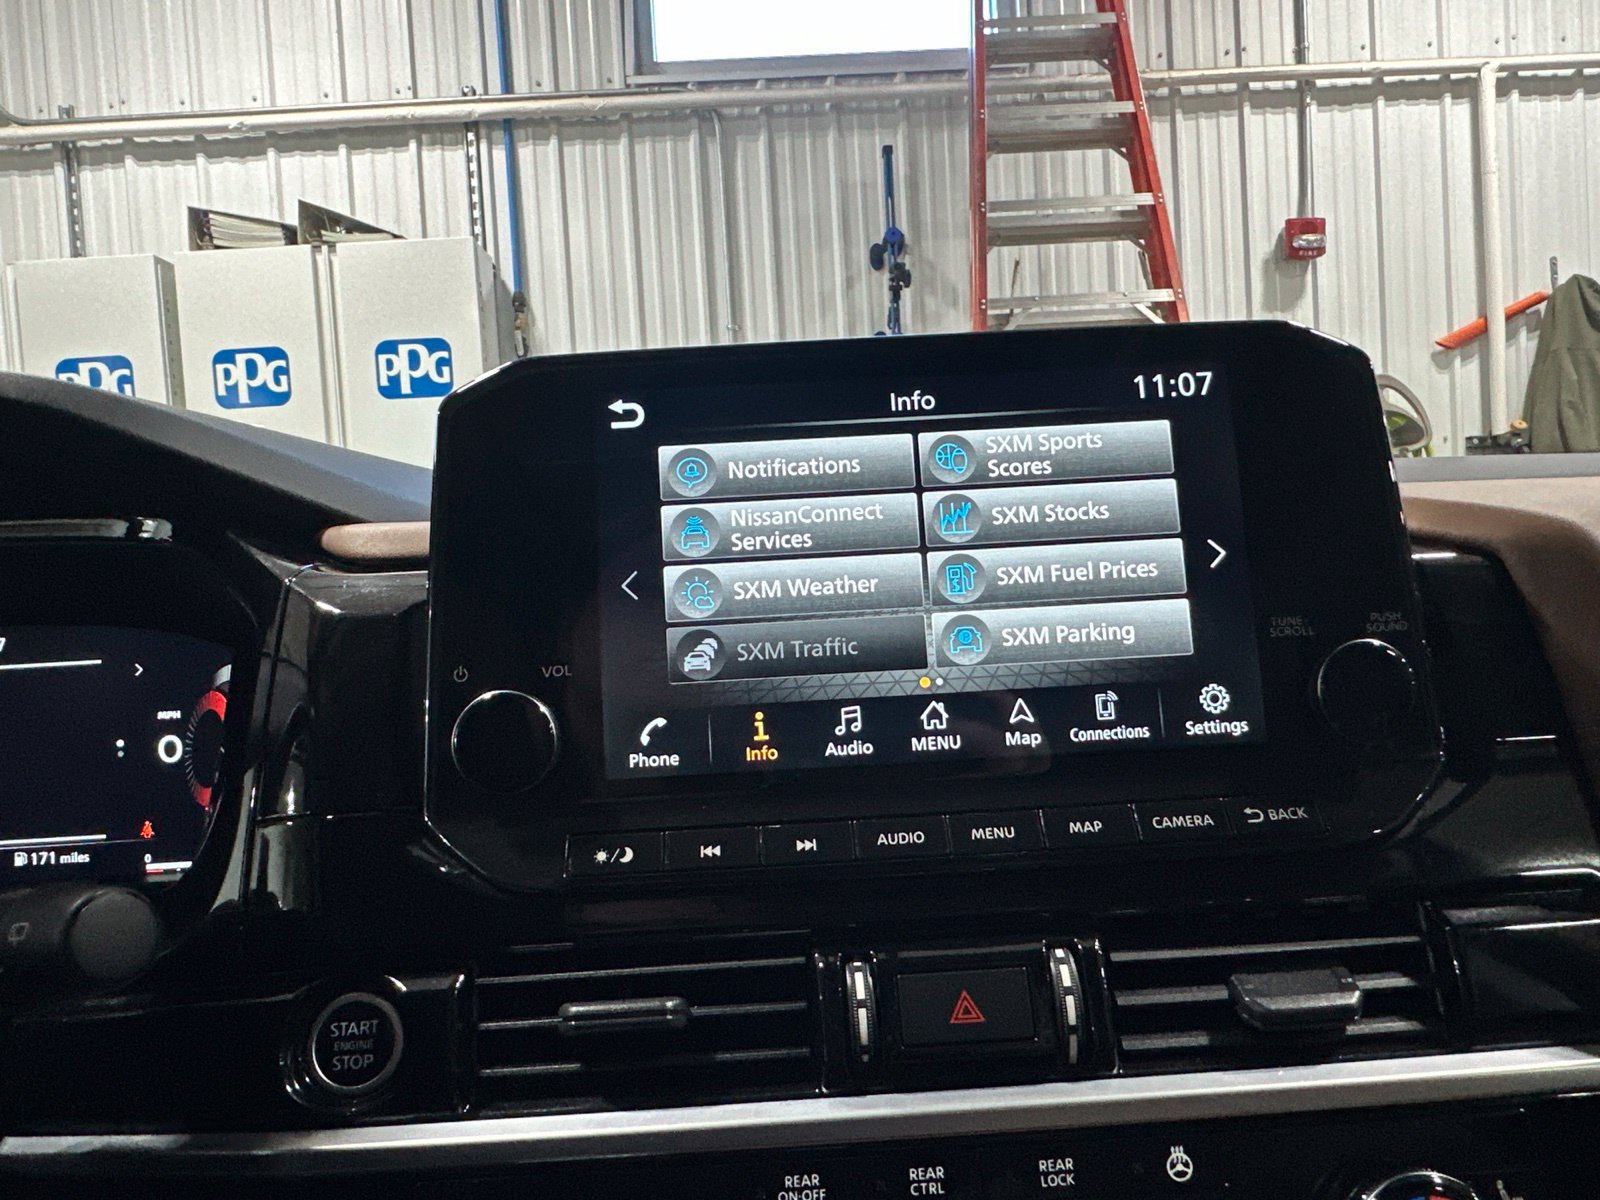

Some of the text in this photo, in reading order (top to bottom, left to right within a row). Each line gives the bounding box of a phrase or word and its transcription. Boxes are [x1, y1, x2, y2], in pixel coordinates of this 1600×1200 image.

[215, 352, 289, 403] PPG
[377, 343, 451, 395] PPG
[1133, 371, 1213, 399] 11:07
[890, 390, 935, 412] Info
[986, 431, 1103, 455] SXM Sports
[728, 457, 861, 479] Notifications
[988, 458, 1052, 478] Scores
[731, 503, 884, 527] NissanConnect
[992, 501, 1110, 525] SXM Stocks
[731, 531, 813, 551] Services
[996, 561, 1158, 585] SXM Fuel Prices
[733, 575, 879, 600] SXM Weather
[1001, 622, 1135, 647] SXM Parking
[1269, 626, 1315, 637] SCROLL
[737, 637, 859, 661] SXM Traffic
[541, 664, 572, 678] VOL
[157, 710, 181, 720] MPH
[1069, 725, 1150, 743] Connections
[1185, 719, 1249, 736] Settings
[911, 734, 961, 751] MENU
[1005, 730, 1041, 748] Map
[157, 734, 183, 763] 0
[746, 746, 778, 761] Info
[825, 740, 874, 757] Audio
[629, 752, 680, 769] Phone
[1151, 813, 1214, 830] CAMERA
[1267, 806, 1308, 821] BACK
[971, 825, 1016, 841] MENU
[1069, 820, 1103, 835] MAP
[877, 831, 926, 846] AUDIO
[31, 852, 90, 866] 171 miles
[144, 853, 152, 863] 0
[330, 1020, 379, 1037] START
[334, 1040, 374, 1051] ENGINE
[332, 1054, 374, 1071] STOP
[908, 1166, 945, 1181] REAR
[1038, 1158, 1074, 1172] REAR
[784, 1174, 820, 1188] REAR
[910, 1182, 945, 1196] CTRL
[1040, 1173, 1075, 1188] LOCK
